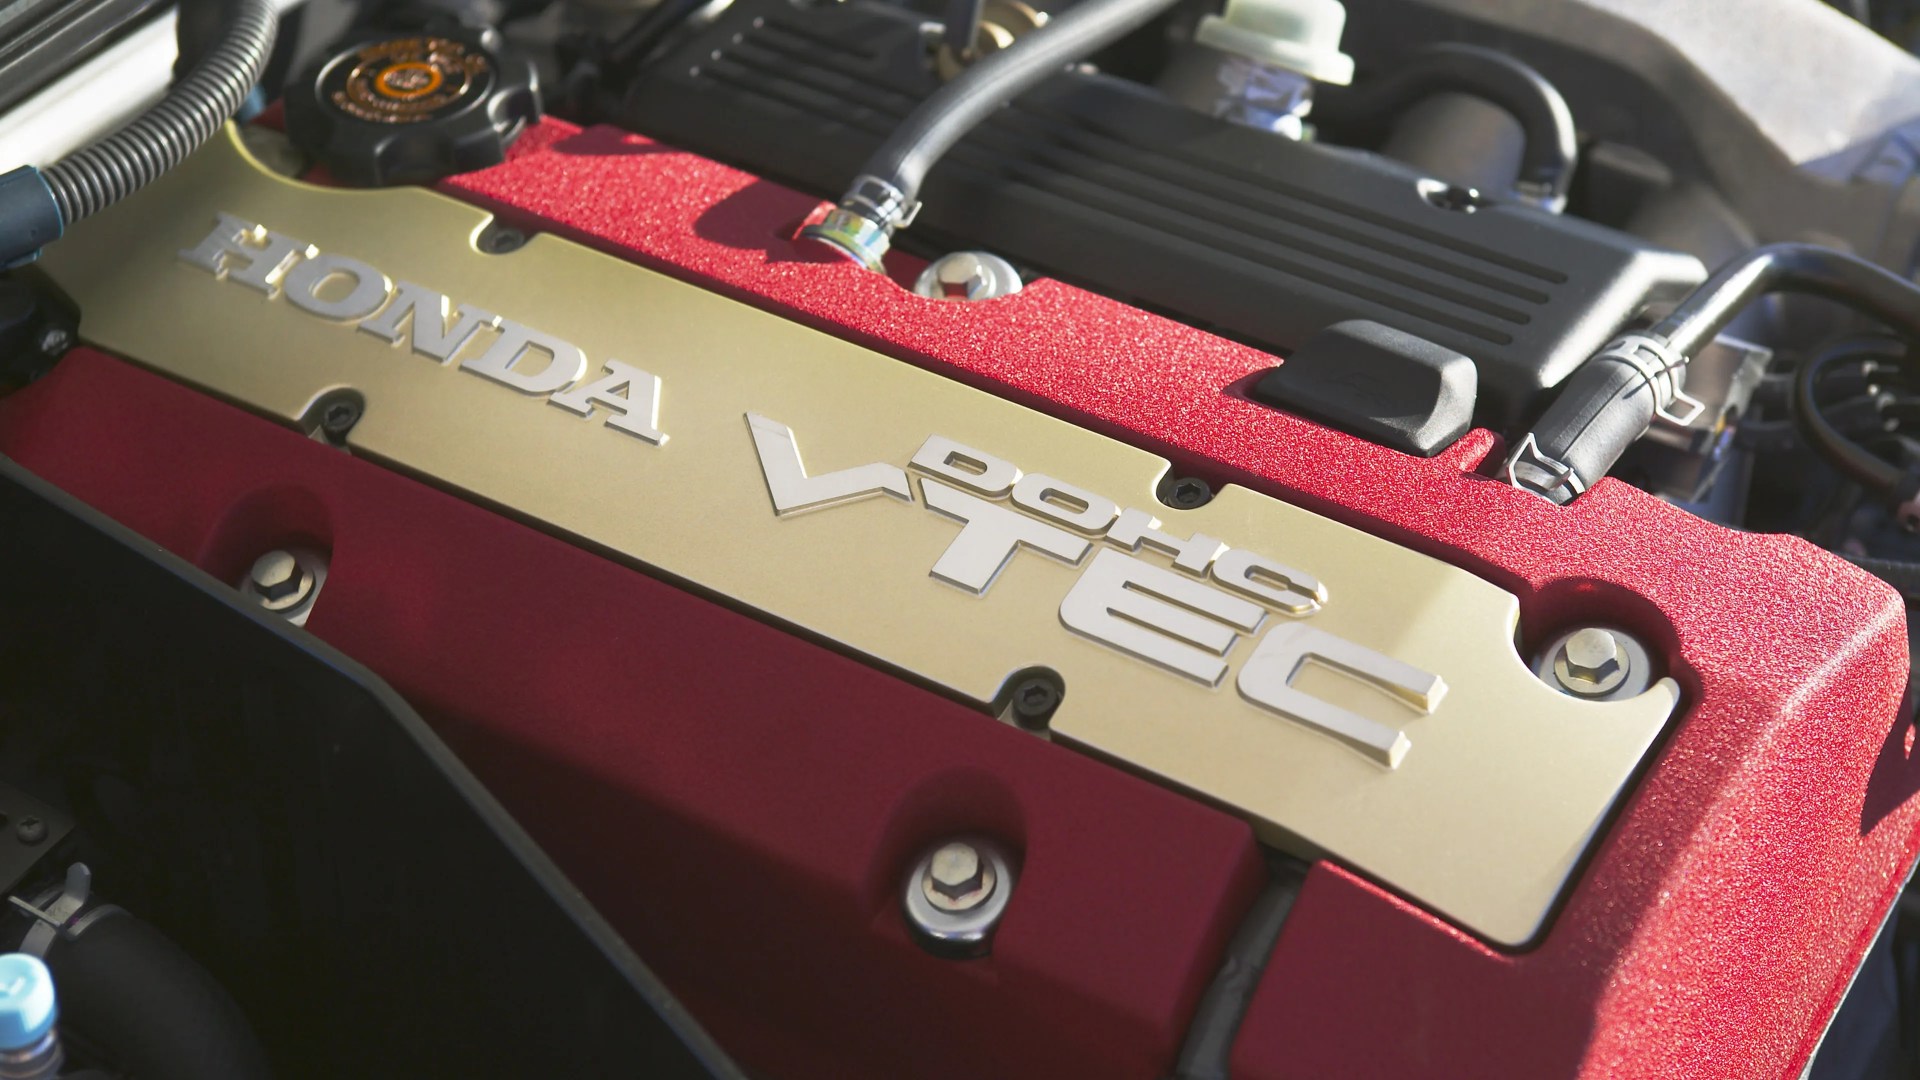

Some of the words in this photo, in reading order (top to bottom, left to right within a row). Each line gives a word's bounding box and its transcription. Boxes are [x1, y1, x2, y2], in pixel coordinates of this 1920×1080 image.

[179, 212, 669, 446] HONDA
[745, 411, 1448, 769] VTEC
[907, 433, 1328, 617] DOHC
